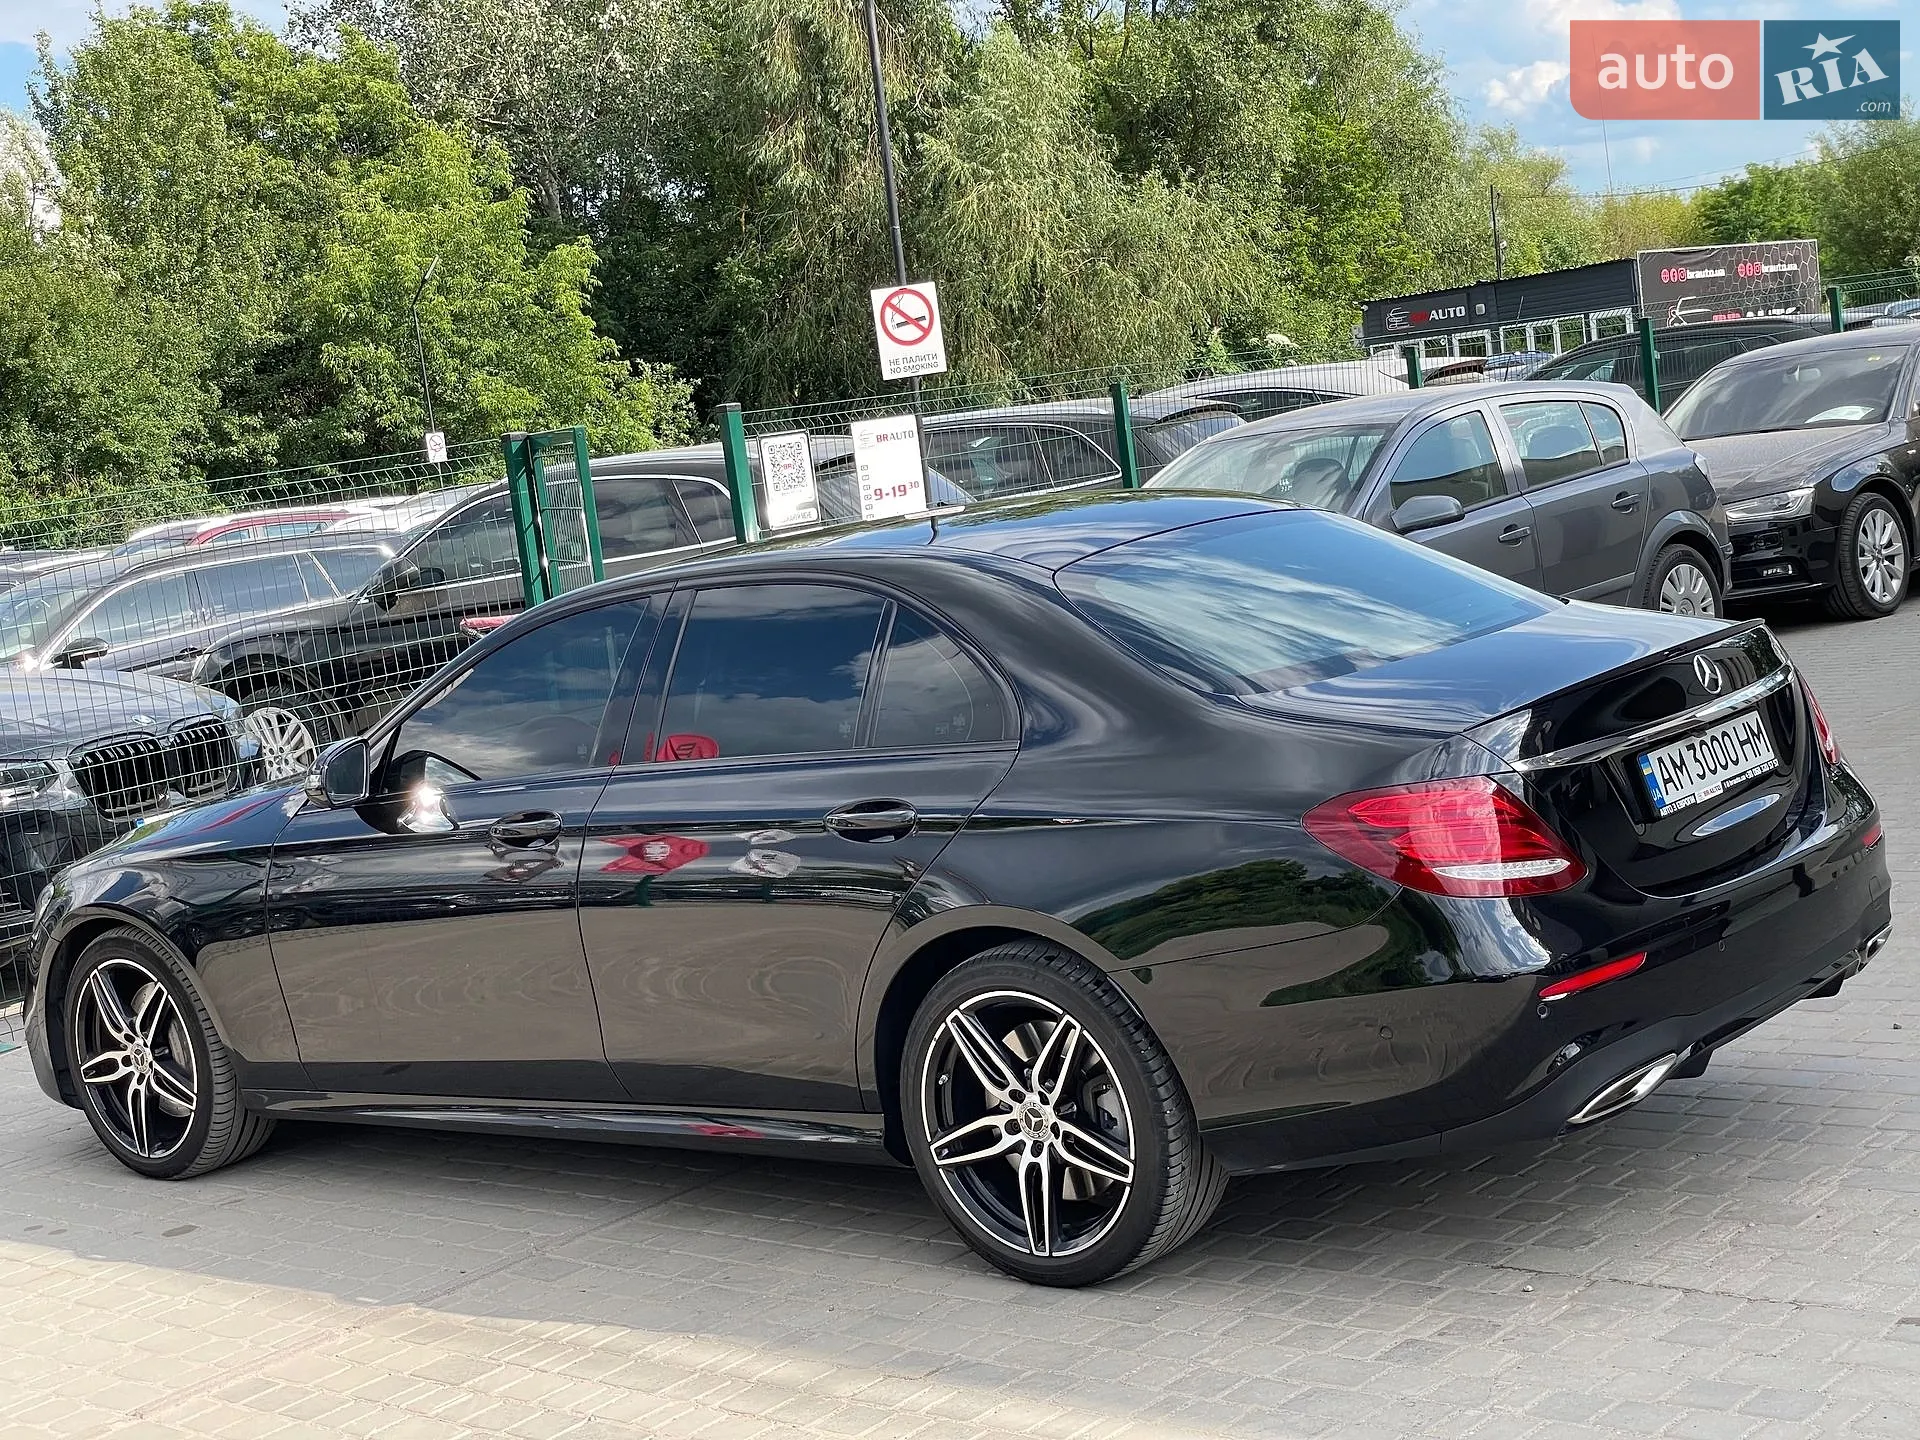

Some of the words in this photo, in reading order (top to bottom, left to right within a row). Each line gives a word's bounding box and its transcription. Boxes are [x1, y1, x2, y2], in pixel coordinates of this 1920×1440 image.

[1409, 306, 1466, 323] AUTO
[889, 357, 900, 367] НЕ
[902, 353, 938, 365] ПАЛИТИ
[890, 366, 902, 375] NO
[903, 361, 939, 373] SMOKING
[876, 430, 914, 443] BRAUTO
[1656, 748, 1694, 796] AM
[1685, 731, 1739, 780] 3000
[1732, 717, 1771, 762] HM
[1650, 788, 1663, 801] UA
